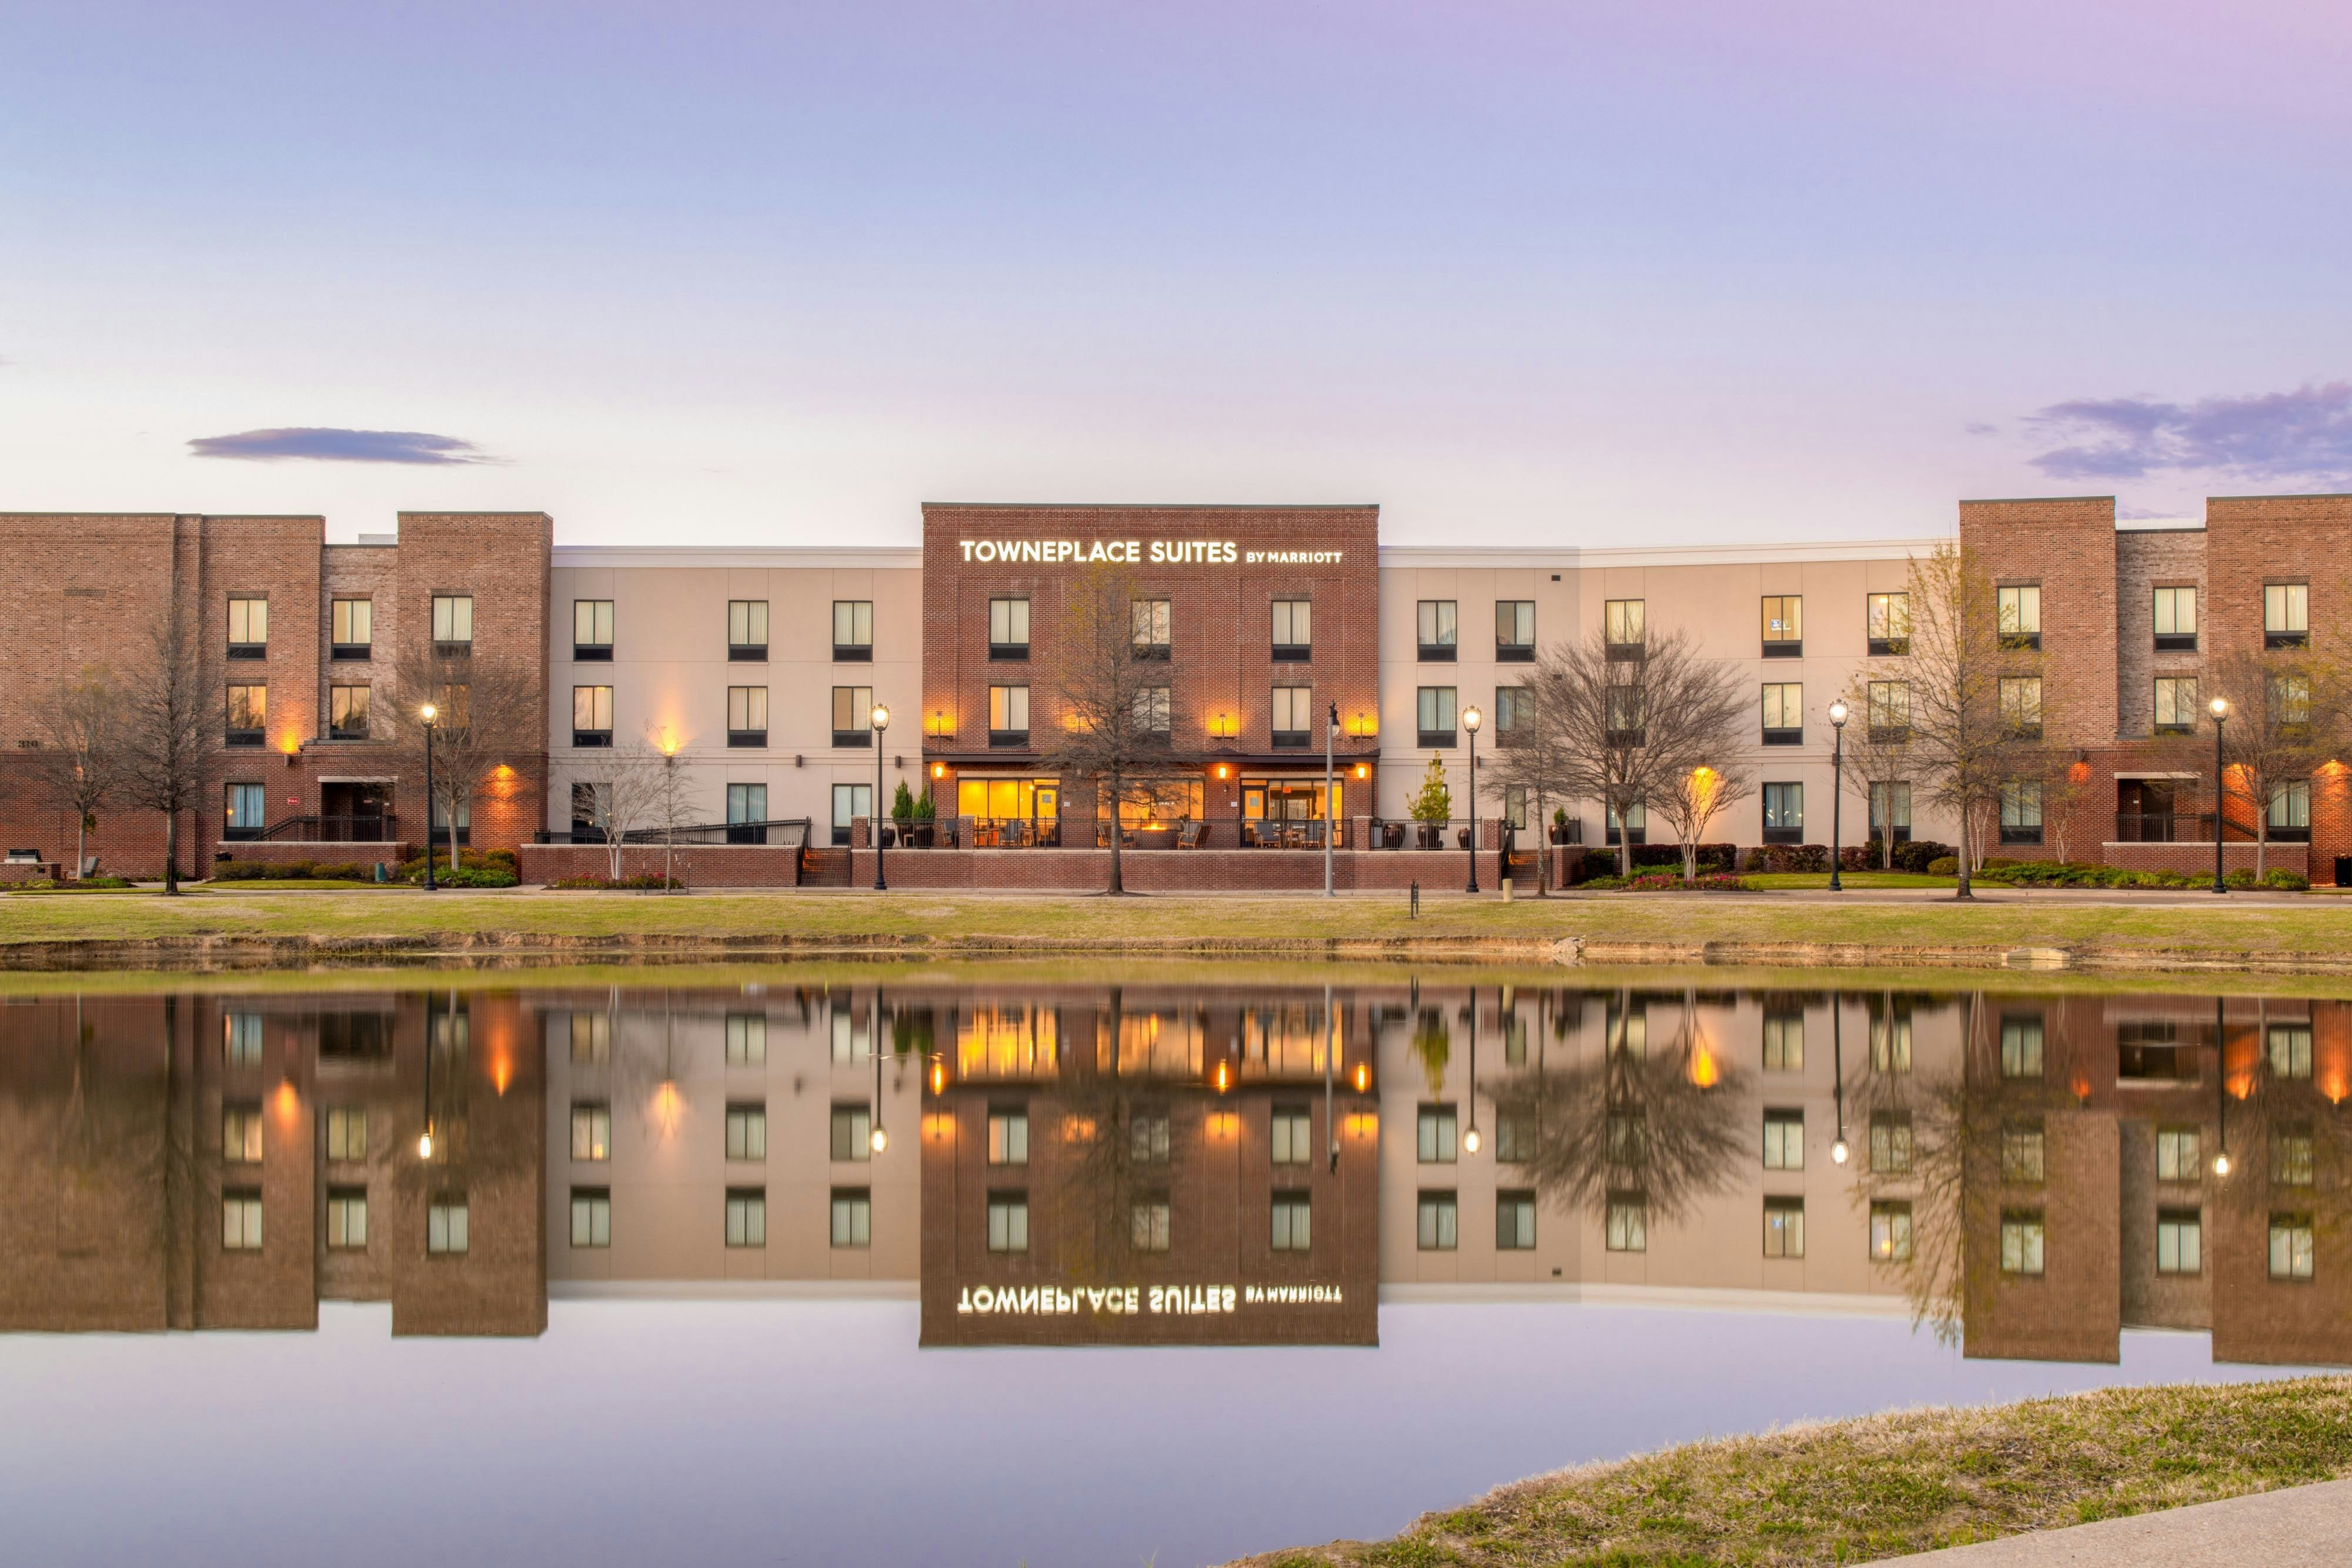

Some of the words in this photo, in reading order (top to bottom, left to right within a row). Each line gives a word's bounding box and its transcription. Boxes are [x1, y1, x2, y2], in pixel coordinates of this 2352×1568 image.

[960, 540, 1140, 562] TOWNEPLACE
[1150, 541, 1237, 563] SUITES
[1246, 551, 1264, 563] BY
[1268, 551, 1342, 563] MARRIOTT
